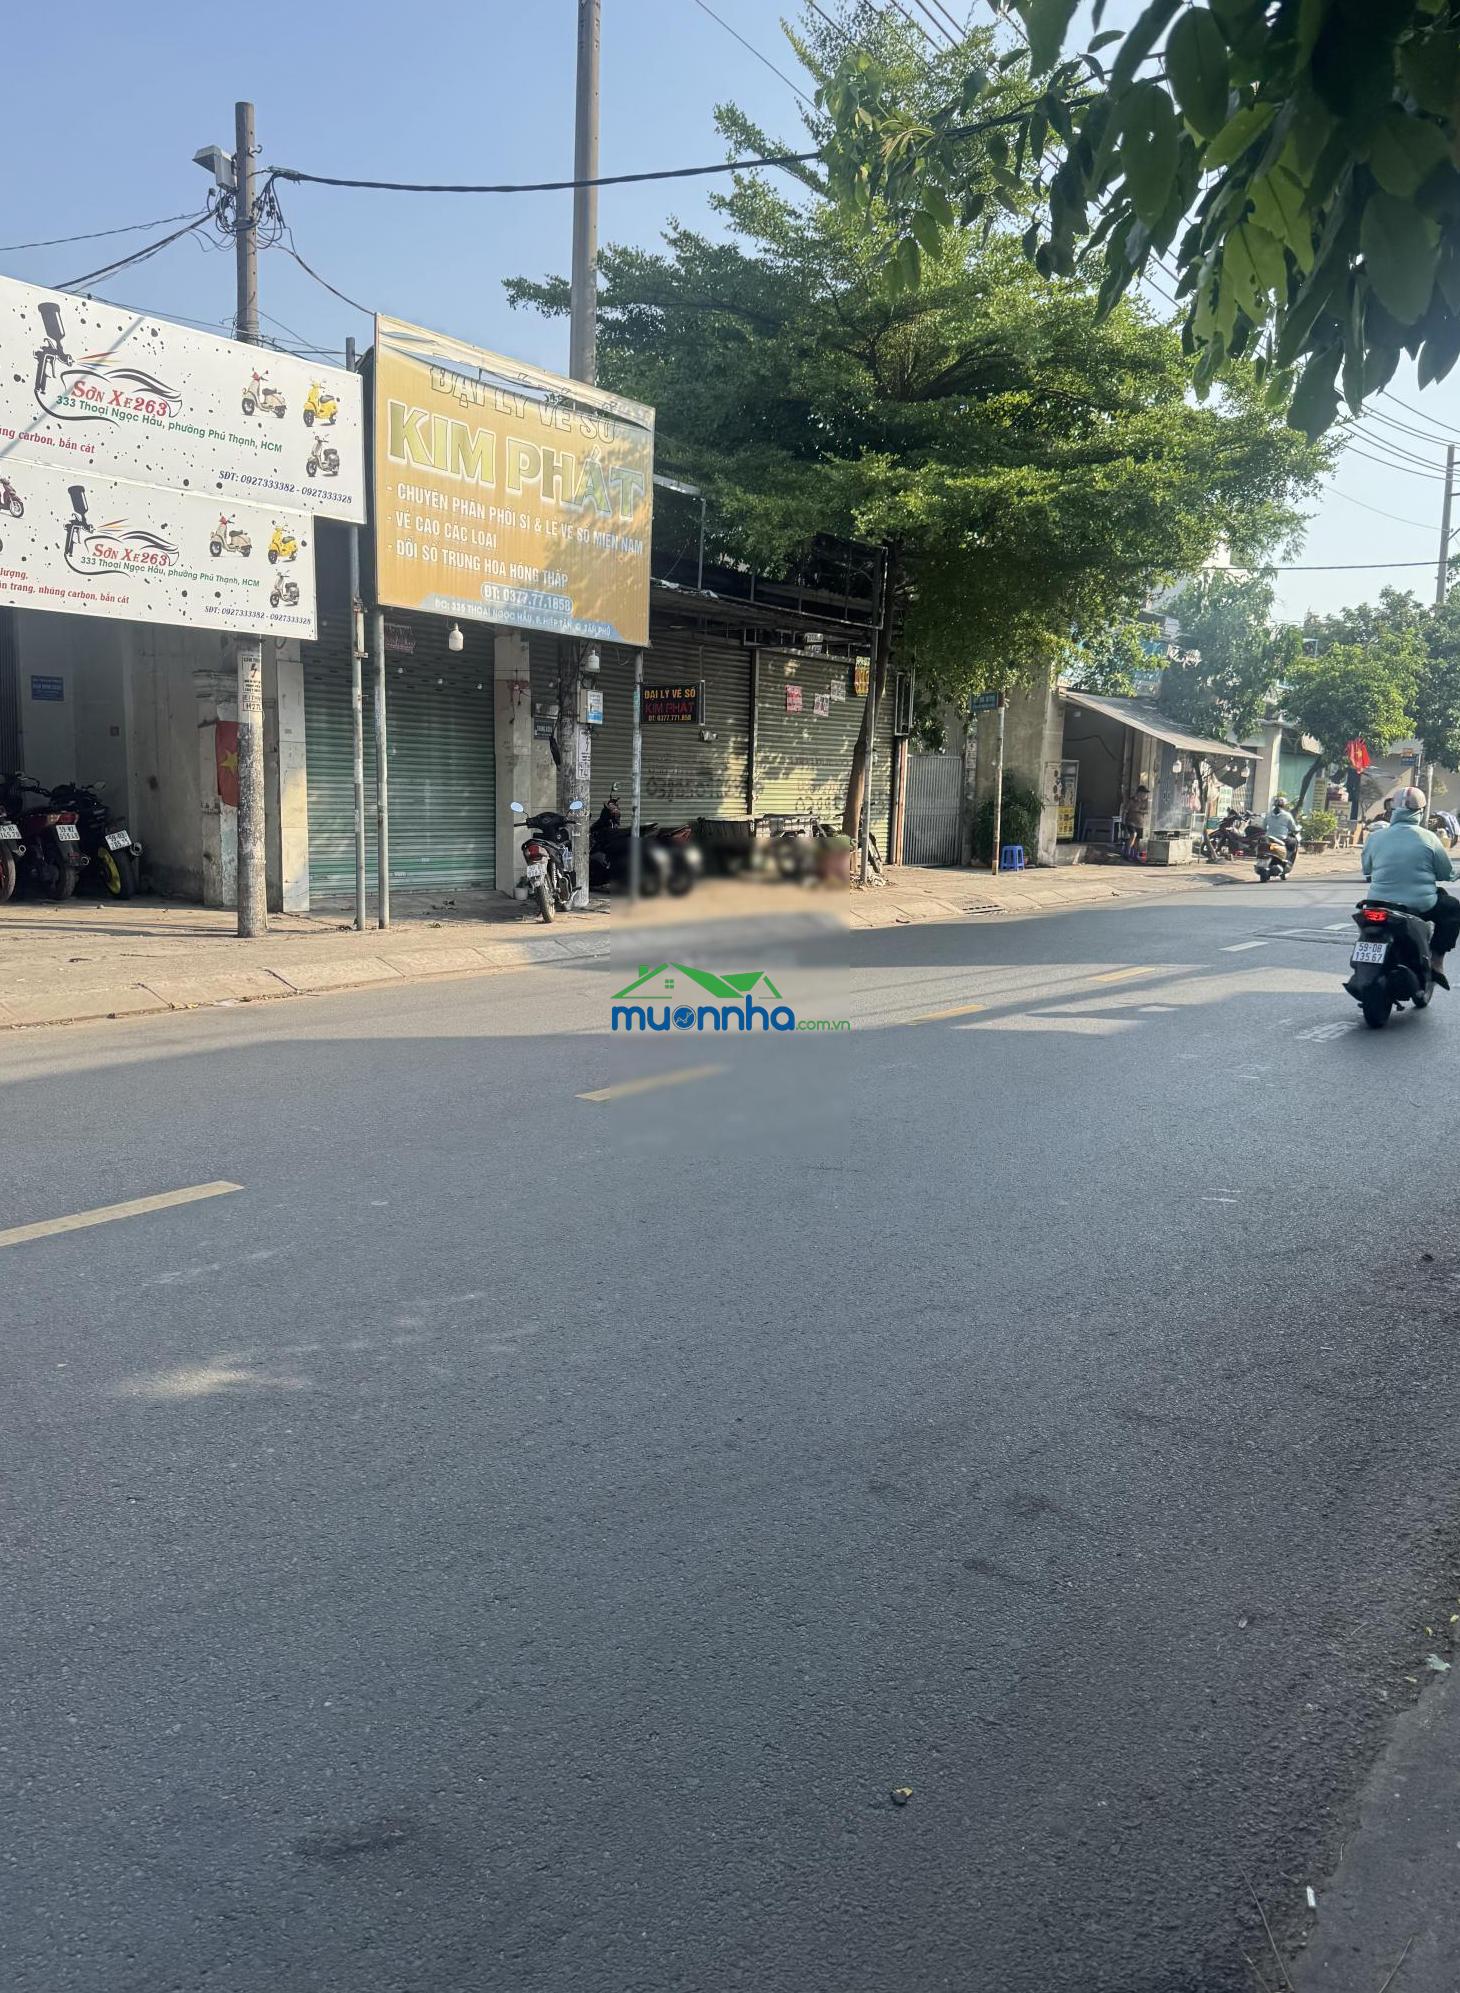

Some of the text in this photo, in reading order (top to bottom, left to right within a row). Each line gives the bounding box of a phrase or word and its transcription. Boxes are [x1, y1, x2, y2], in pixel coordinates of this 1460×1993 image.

[56, 395, 77, 408] 333
[79, 400, 108, 416] Thoại
[111, 408, 139, 423] Ngọc
[168, 420, 205, 438] phường
[208, 428, 226, 440] Phú
[260, 440, 283, 452] HCM
[80, 444, 95, 453] cát
[387, 399, 646, 521] KIM PHÁT
[218, 470, 239, 482] SĐT:
[240, 474, 295, 492] 0927333382
[398, 483, 448, 510] CHUYÊN
[452, 498, 486, 519] PHÂN
[534, 518, 542, 532] &
[621, 536, 643, 554] NAM
[444, 522, 468, 542] CÁC
[472, 529, 496, 550] LOẠI
[80, 556, 96, 566] 333
[99, 558, 122, 569] Thoại
[123, 562, 146, 574] Ngọc
[242, 579, 260, 587] HCM
[442, 548, 480, 570] TRÚNG
[484, 558, 506, 576] HOA
[204, 606, 220, 614] SĐT:
